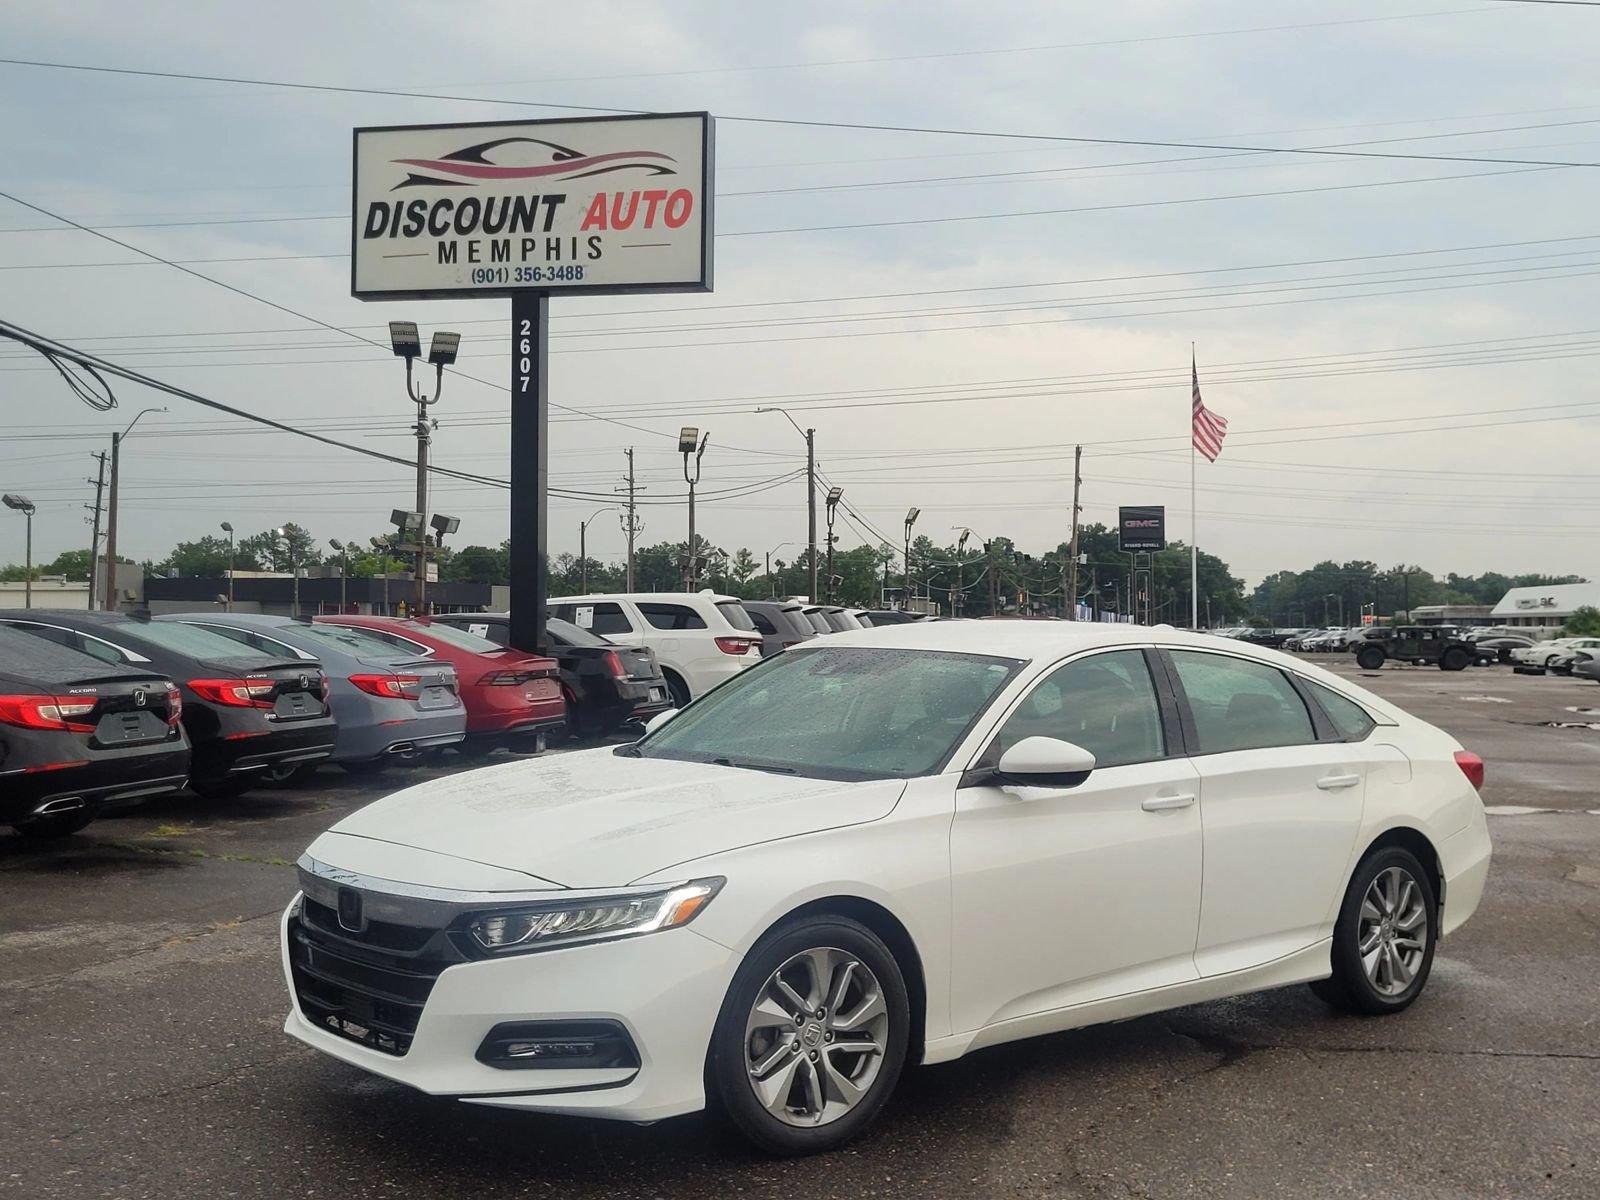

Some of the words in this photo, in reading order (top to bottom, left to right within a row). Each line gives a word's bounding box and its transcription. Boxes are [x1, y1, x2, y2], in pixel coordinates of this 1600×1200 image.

[364, 194, 566, 239] DISCOUNT
[580, 189, 693, 231] AUTO
[438, 236, 602, 264] MEMPHIS
[471, 267, 509, 284] (901)
[514, 265, 584, 282] 356-3488
[520, 319, 531, 392] 2607
[1124, 519, 1159, 528] GMC
